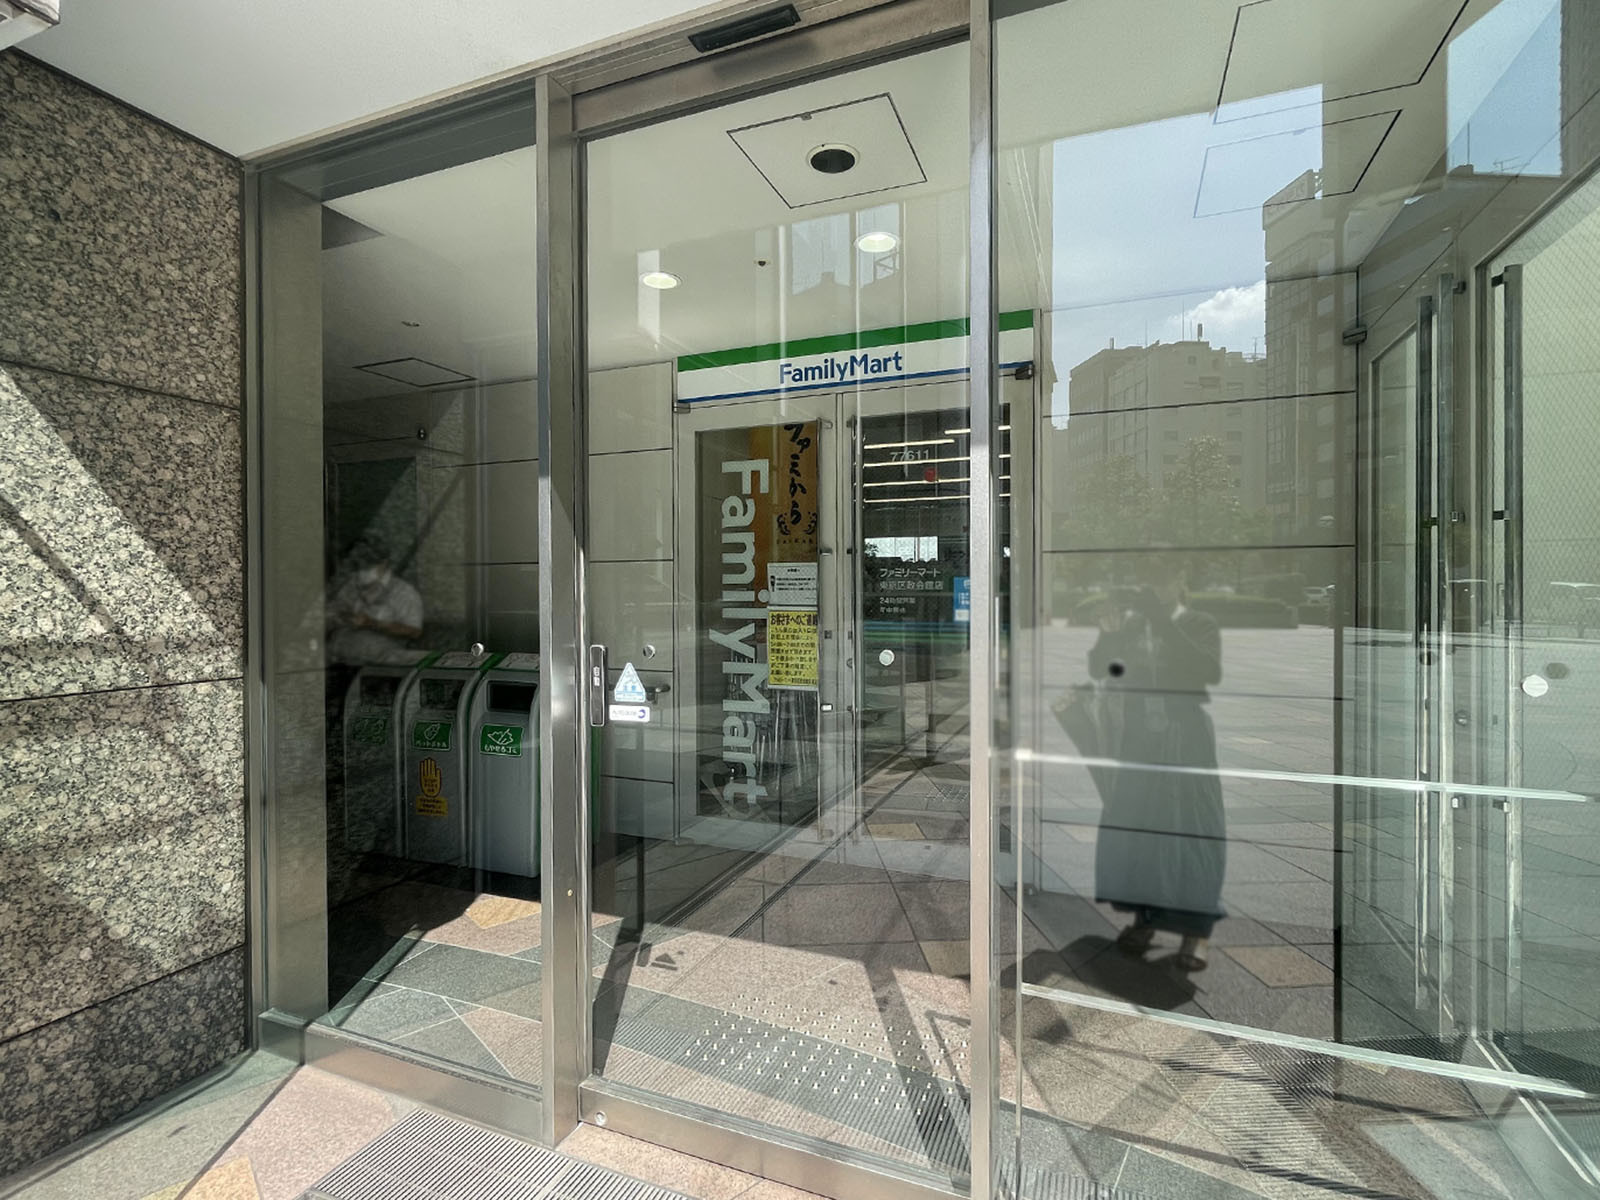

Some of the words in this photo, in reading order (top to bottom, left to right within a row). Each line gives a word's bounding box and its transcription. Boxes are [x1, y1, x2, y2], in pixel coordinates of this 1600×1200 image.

[779, 351, 903, 384] FamilyMart
[889, 449, 929, 462] 77611
[879, 568, 942, 578] ファミリーマート
[708, 459, 770, 804] FamilyMart
